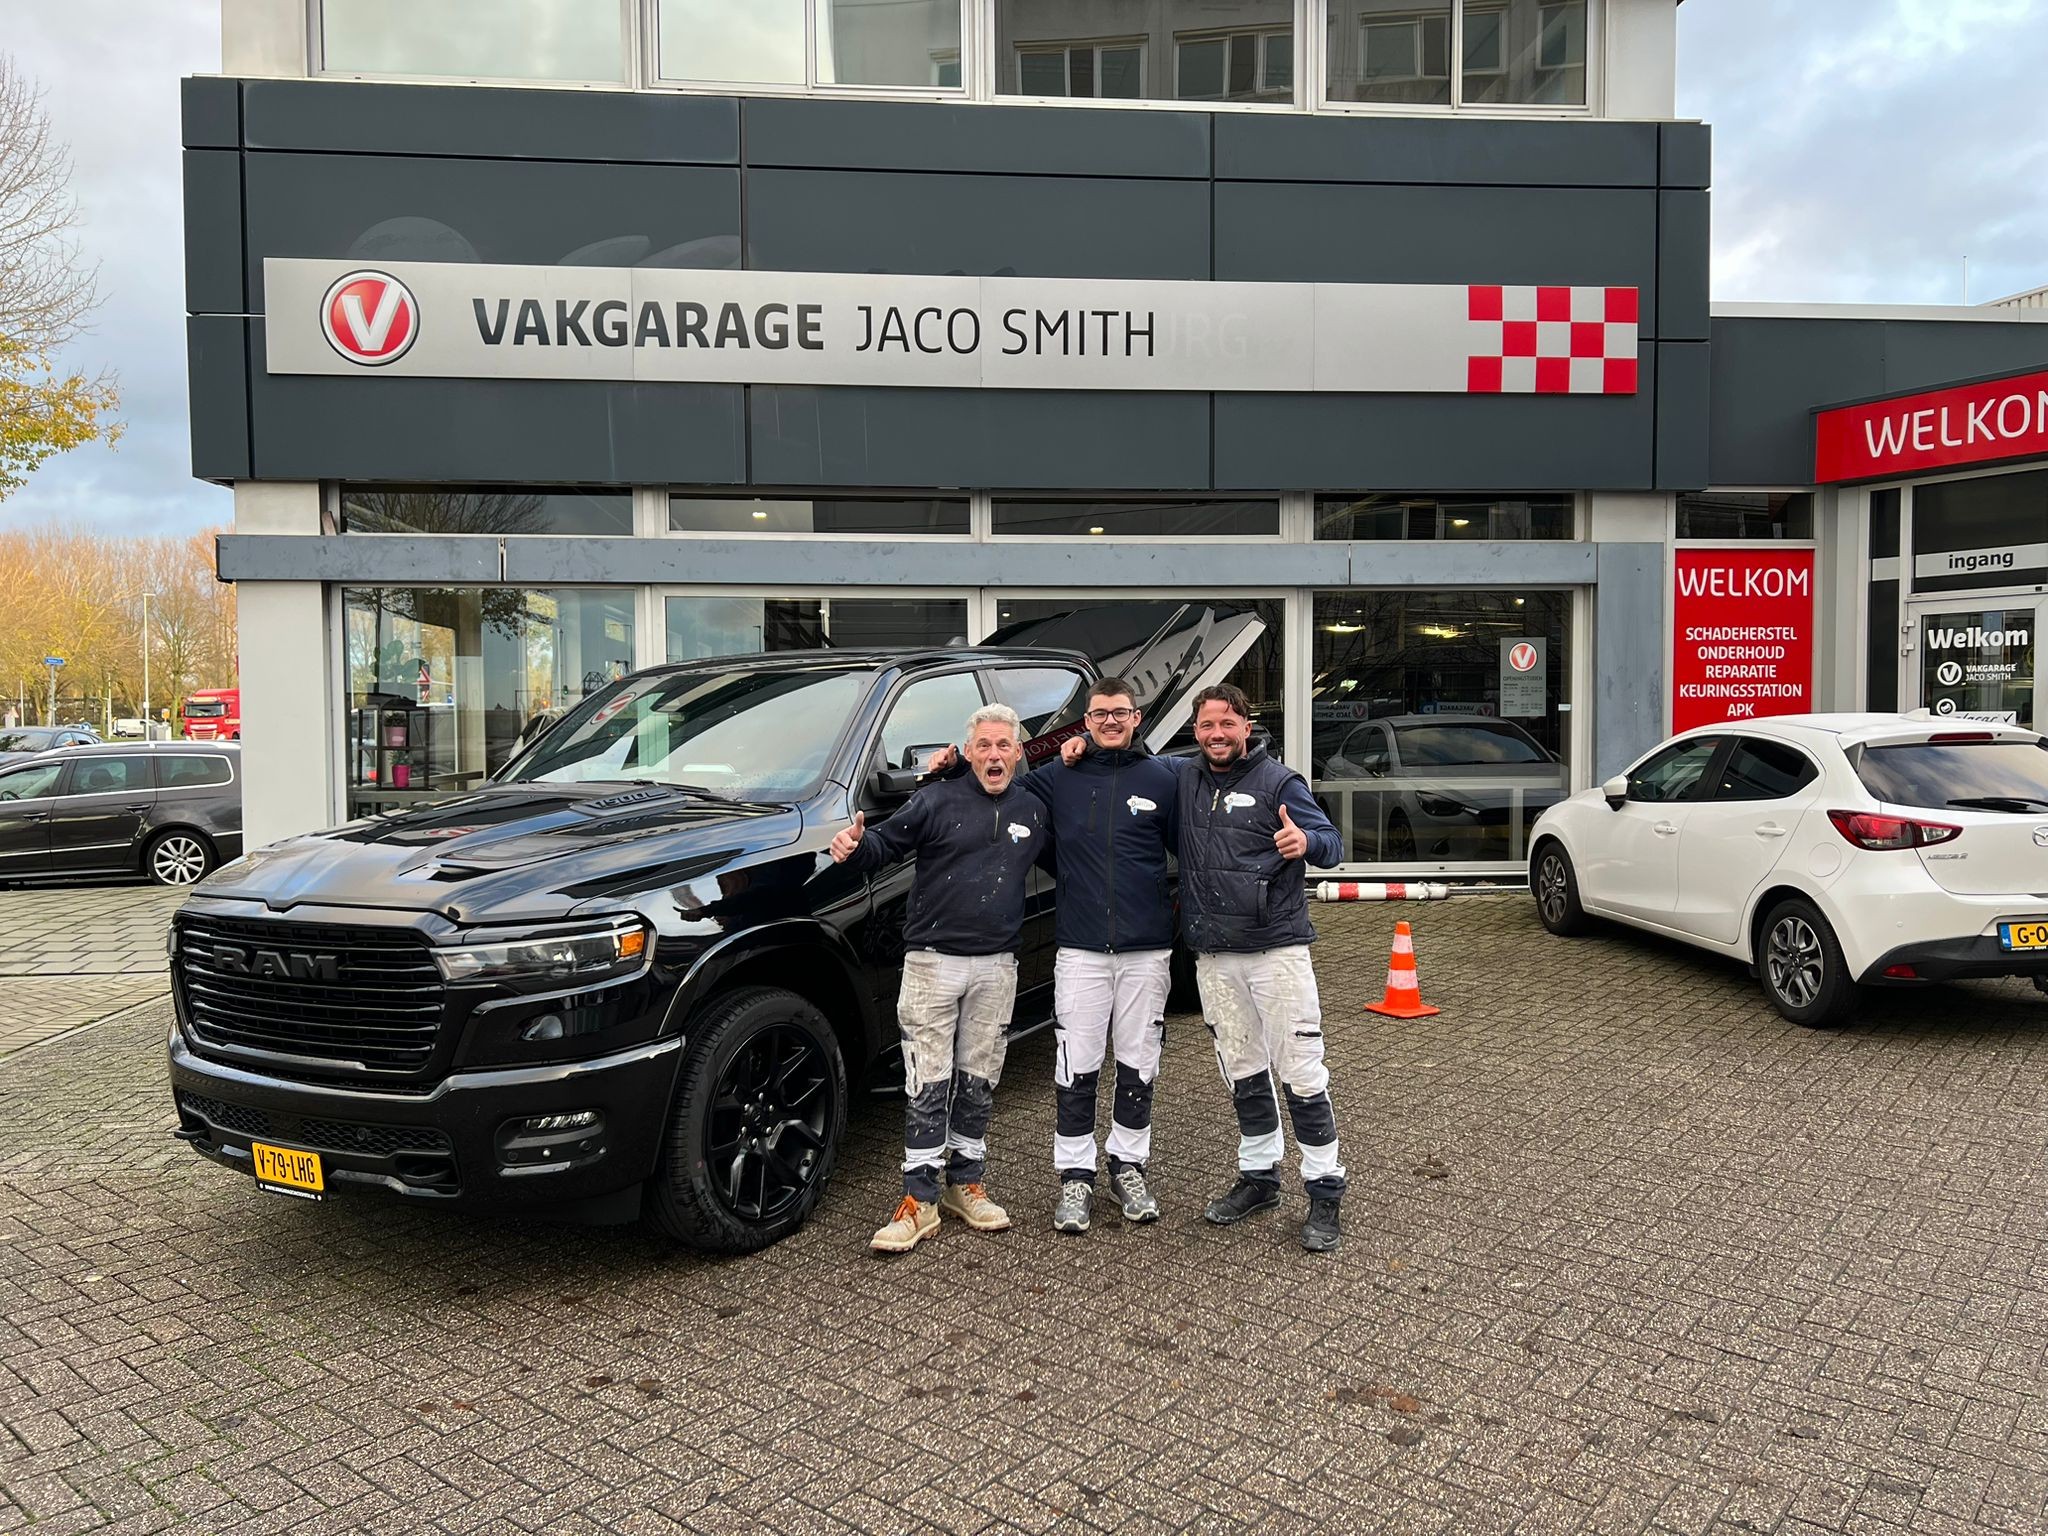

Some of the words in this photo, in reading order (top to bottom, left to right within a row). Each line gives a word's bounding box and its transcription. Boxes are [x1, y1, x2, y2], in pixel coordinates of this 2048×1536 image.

[473, 298, 824, 350] VAKGARAGE
[856, 306, 981, 355] JACO
[1002, 309, 1154, 357] SMITH
[1948, 552, 2014, 572] ingang
[1678, 568, 1808, 597] WELKOM
[1686, 627, 1797, 641] SCHADEHERSTEL
[1928, 627, 2028, 649] Welkom
[1698, 646, 1785, 660] ONDERHOUD
[1706, 665, 1777, 679] REPARATIE
[1966, 664, 2016, 673] VAKGARAGE
[1966, 673, 1985, 682] JACO
[1987, 673, 2012, 682] SMITH
[1680, 684, 1802, 698] KEURINGSSTATION
[1727, 703, 1755, 717] APK
[213, 945, 338, 979] RAM
[257, 1148, 316, 1184] V-79-LHG
